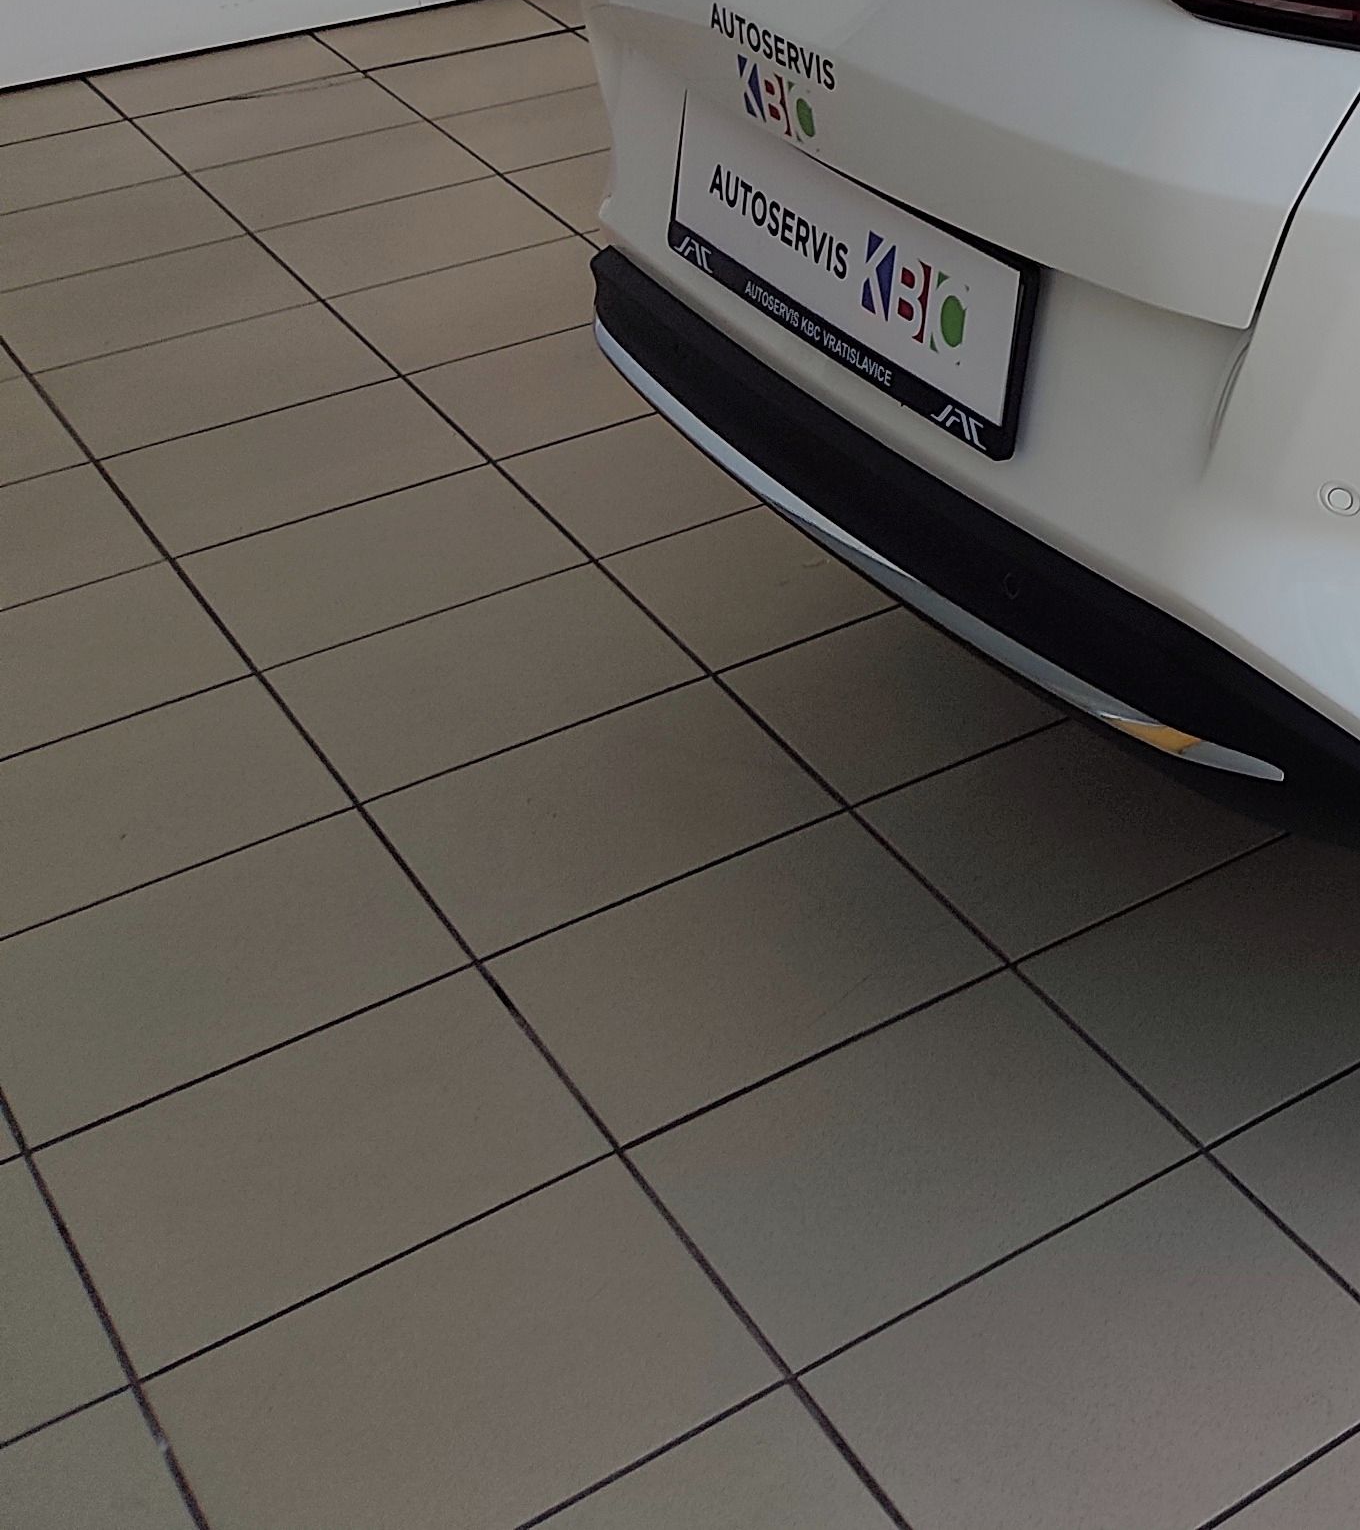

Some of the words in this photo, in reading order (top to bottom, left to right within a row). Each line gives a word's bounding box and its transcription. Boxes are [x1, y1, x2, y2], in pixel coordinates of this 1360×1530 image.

[710, 2, 836, 91] AUTOSERVIS
[675, 236, 714, 274] JAC
[708, 164, 849, 280] AUTOSERVIS
[744, 280, 800, 328] AUTOSERVIS
[800, 316, 821, 342] KBC
[822, 329, 893, 387] VRATISLAVICE
[931, 403, 988, 451] JAC
